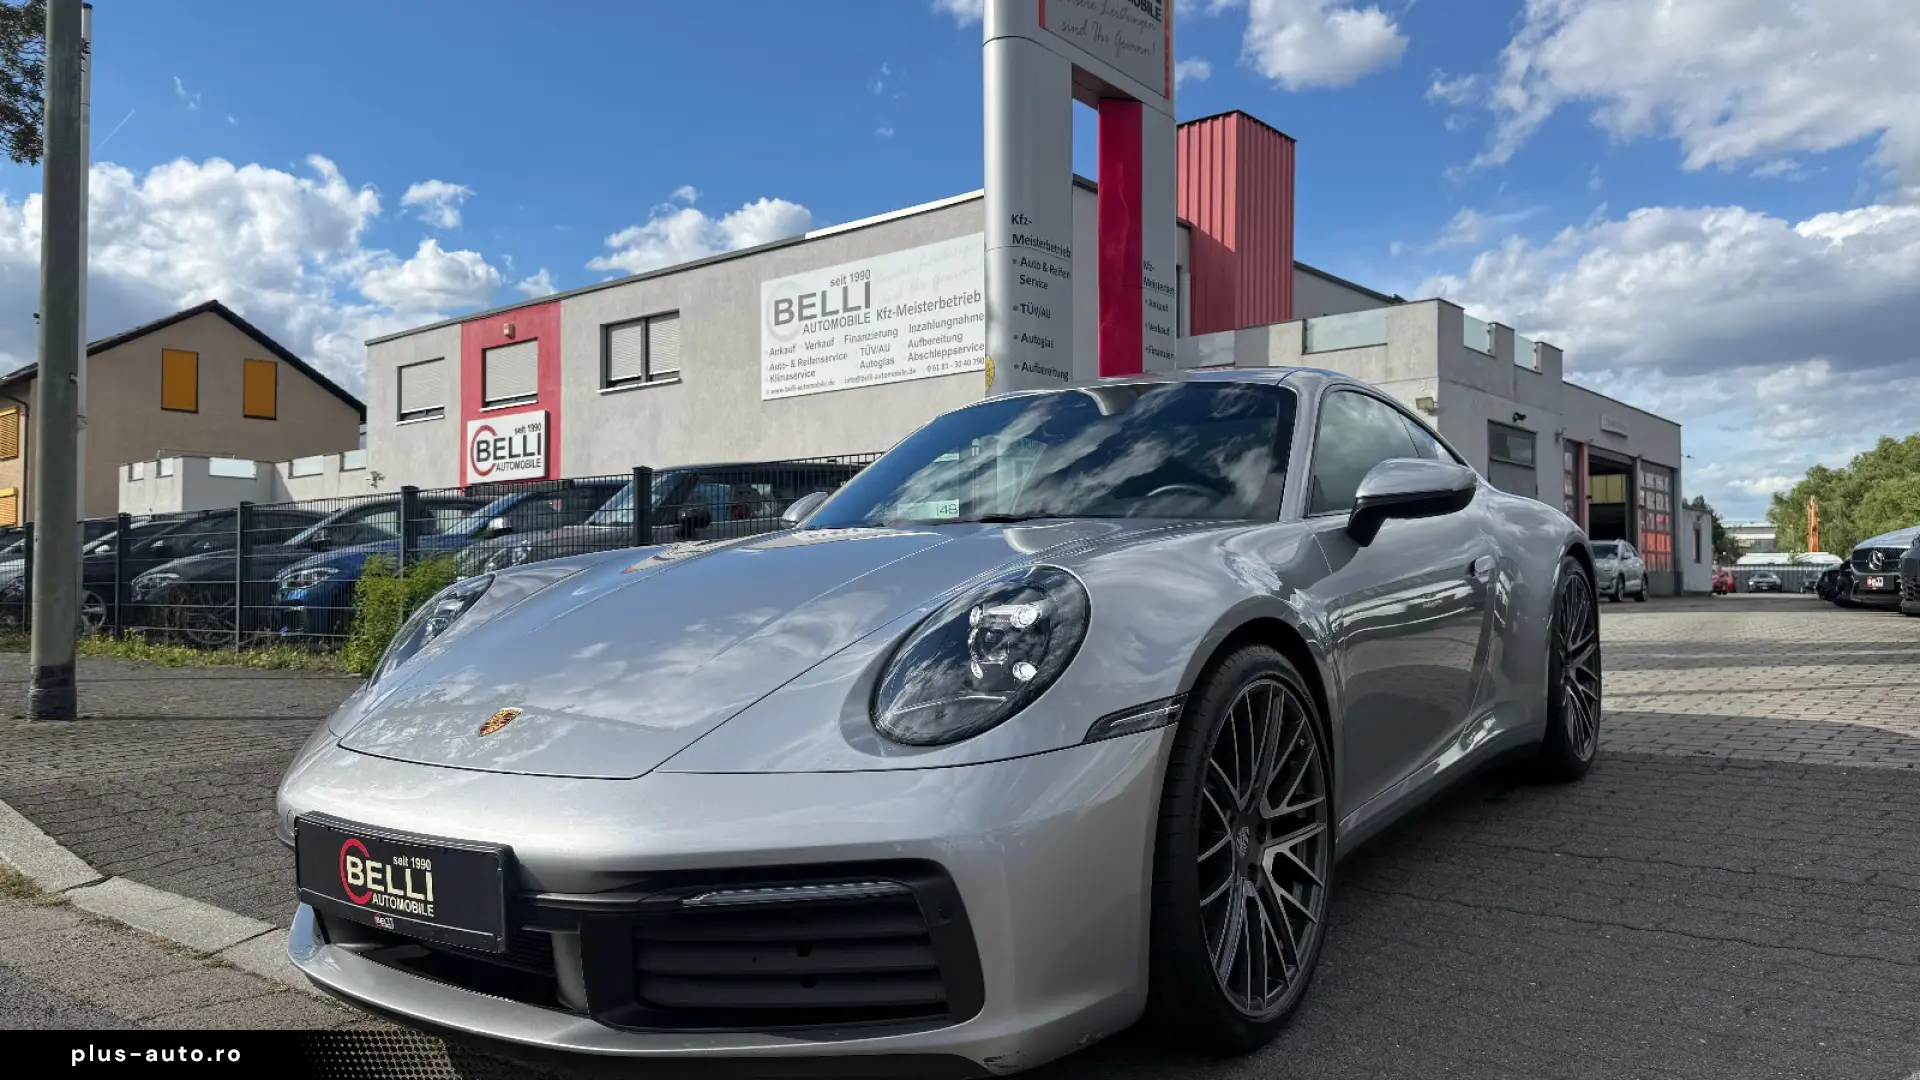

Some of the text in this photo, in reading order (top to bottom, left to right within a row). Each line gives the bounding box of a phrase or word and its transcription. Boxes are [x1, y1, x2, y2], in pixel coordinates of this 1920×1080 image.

[1129, 0, 1162, 22] OBILE
[1061, 18, 1088, 36] sind
[1011, 213, 1033, 225] Kfz-
[1012, 233, 1071, 259] Meisterbetrieb
[1020, 256, 1041, 271] Auto
[1042, 261, 1049, 273] &
[830, 269, 871, 288] seit 1990
[1019, 274, 1049, 290] Service
[773, 280, 871, 327] BELLI
[876, 289, 982, 322] Kfz-Meisterbetrieb
[1020, 302, 1051, 319] TÜV/AU
[769, 311, 985, 357] Ankauf Verkauf Finanzierung Inzahlungnahme
[802, 311, 871, 336] AUTOMOBILE
[790, 358, 797, 369] &
[797, 352, 848, 368] Reifenservice
[860, 342, 891, 357] TÜV/AU
[907, 332, 964, 350] Aufbereitung
[1021, 332, 1054, 349] Autoglas
[769, 342, 985, 384] Klimaservice Autoglas Abschleppservice
[1021, 361, 1069, 383] Aufbereitung
[514, 422, 542, 435] seit 1990
[476, 432, 542, 463] BELLI
[496, 458, 542, 472] AUTOMOBILE
[393, 855, 432, 871] seit 1990
[346, 855, 434, 902] BELLI
[372, 891, 435, 918] AUTOMOBILE
